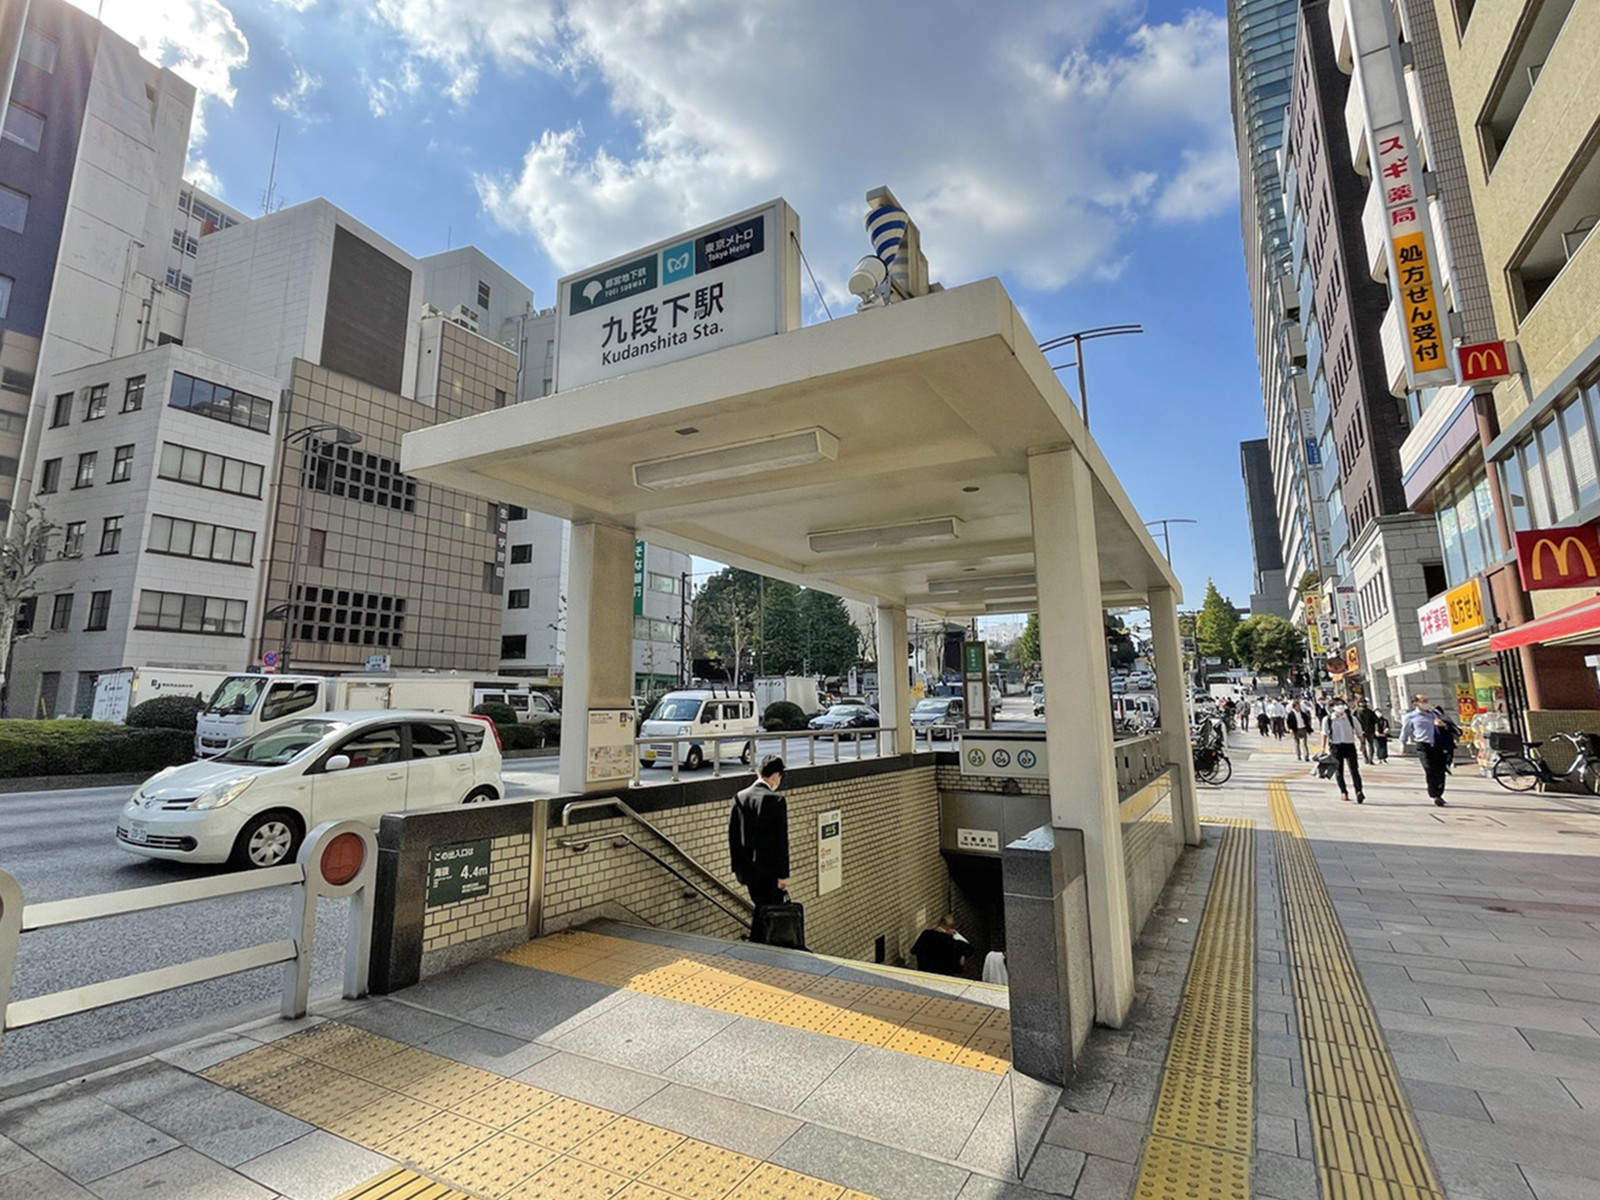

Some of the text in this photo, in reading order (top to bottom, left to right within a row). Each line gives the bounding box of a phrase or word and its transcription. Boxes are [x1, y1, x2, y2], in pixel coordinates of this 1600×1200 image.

[1379, 136, 1417, 226] スギ薬局
[705, 228, 754, 254] 東京メトロ
[708, 242, 751, 262] Tokyo Metro
[604, 278, 647, 298] TOEI SUBWAY
[1399, 243, 1438, 362] 処方せん受付
[601, 282, 724, 348] 九段下駅
[602, 321, 724, 366] Kudanshita Sta.
[460, 864, 488, 879] 4.4m
